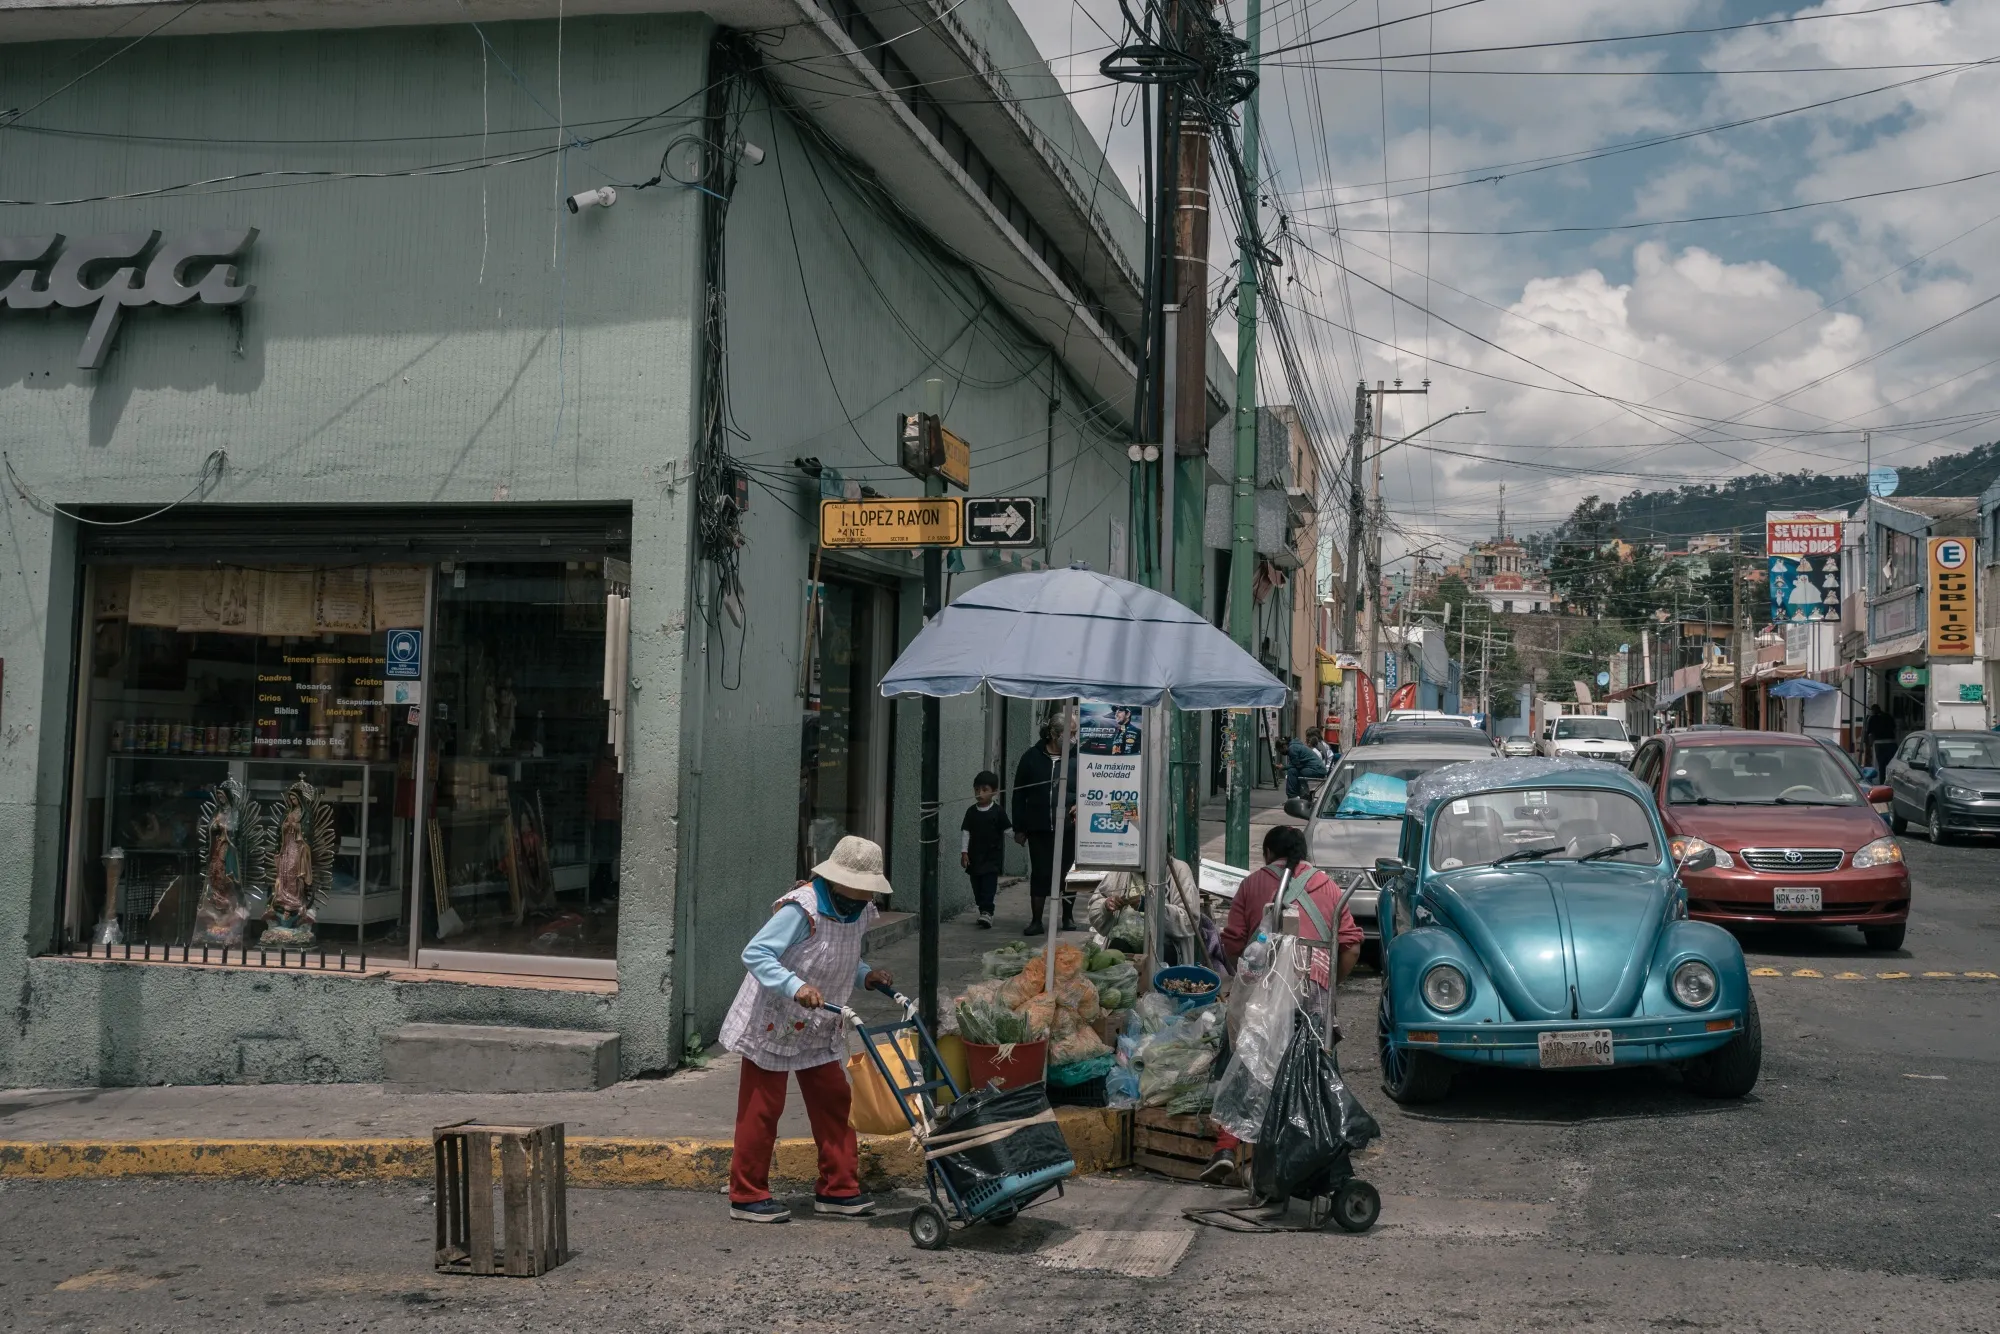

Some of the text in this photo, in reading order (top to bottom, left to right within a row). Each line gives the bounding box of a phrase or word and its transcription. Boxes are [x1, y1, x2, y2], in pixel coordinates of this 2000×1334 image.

[853, 510, 893, 526] LOPEZ
[898, 508, 940, 526] RAYON
[1774, 524, 1834, 538] SE VISTEN
[1772, 538, 1836, 553] NIÑOS DIOS
[1943, 546, 1960, 562] E
[1939, 573, 1967, 642] PUBLICO
[1363, 679, 1372, 726] ROSTIC
[326, 709, 363, 717] Mortajas
[254, 736, 291, 745] Imagenes
[1087, 790, 1103, 800] 50
[1110, 790, 1138, 801] 1000
[1776, 894, 1820, 904] NRK-69-19
